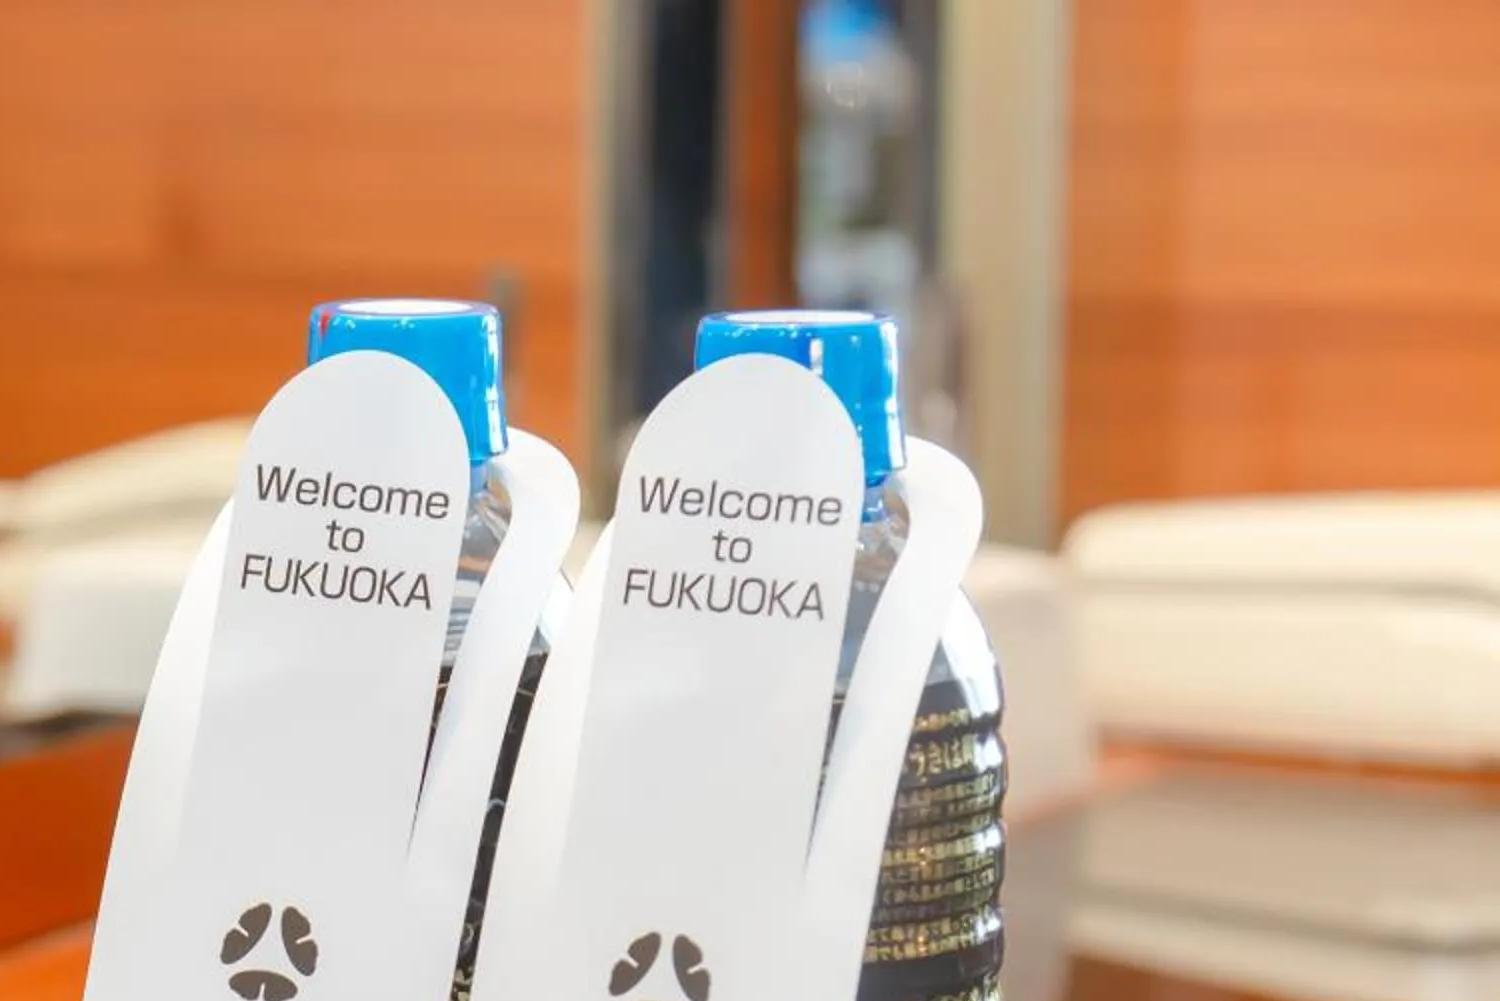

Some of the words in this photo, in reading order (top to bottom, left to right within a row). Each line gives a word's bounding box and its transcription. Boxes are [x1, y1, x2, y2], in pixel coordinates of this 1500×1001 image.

[255, 464, 451, 520] Welcome
[638, 475, 844, 526] Welcome
[325, 519, 366, 554] to
[711, 529, 754, 564] to
[239, 554, 433, 611] FUKUOKA
[621, 569, 825, 621] FUKUOKA
